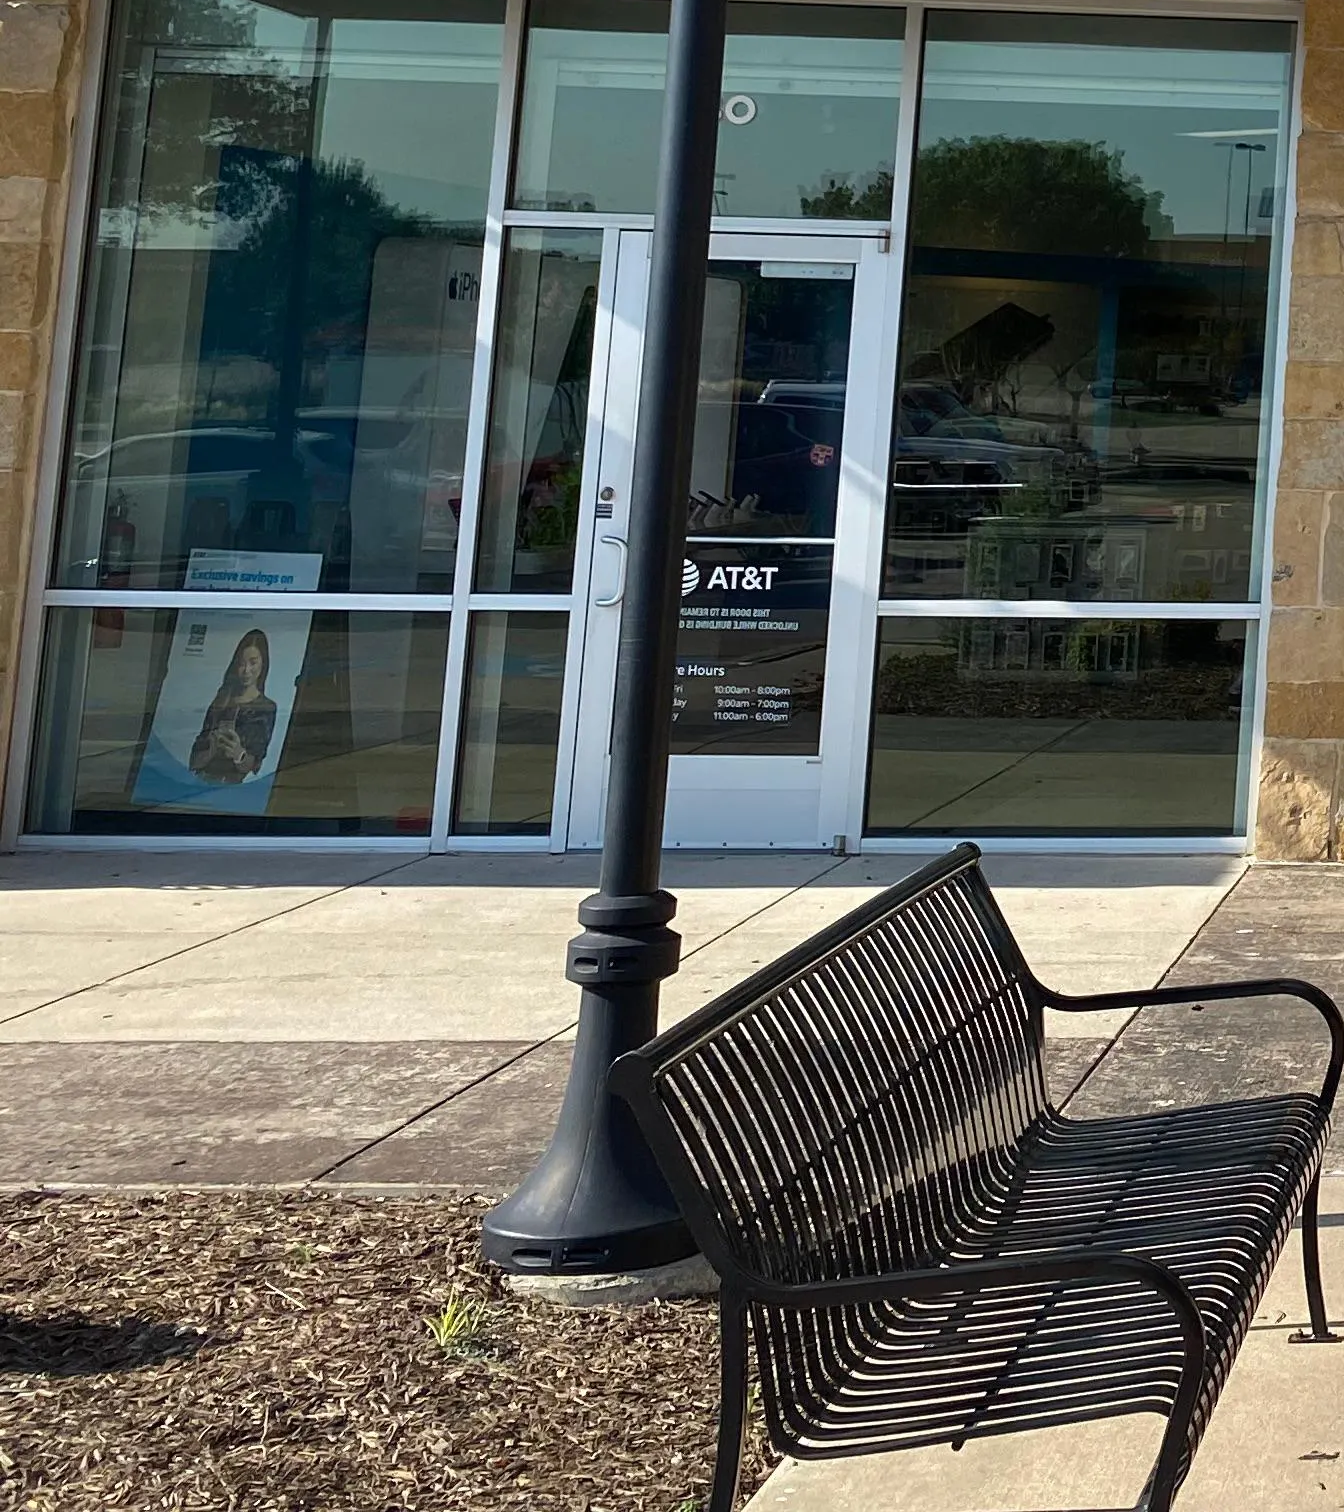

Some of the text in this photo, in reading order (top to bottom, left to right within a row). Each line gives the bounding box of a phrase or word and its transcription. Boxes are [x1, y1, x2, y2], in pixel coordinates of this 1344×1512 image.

[191, 568, 294, 585] Exclusive savings on
[707, 566, 779, 590] AT&T
[688, 664, 725, 677] Hours
